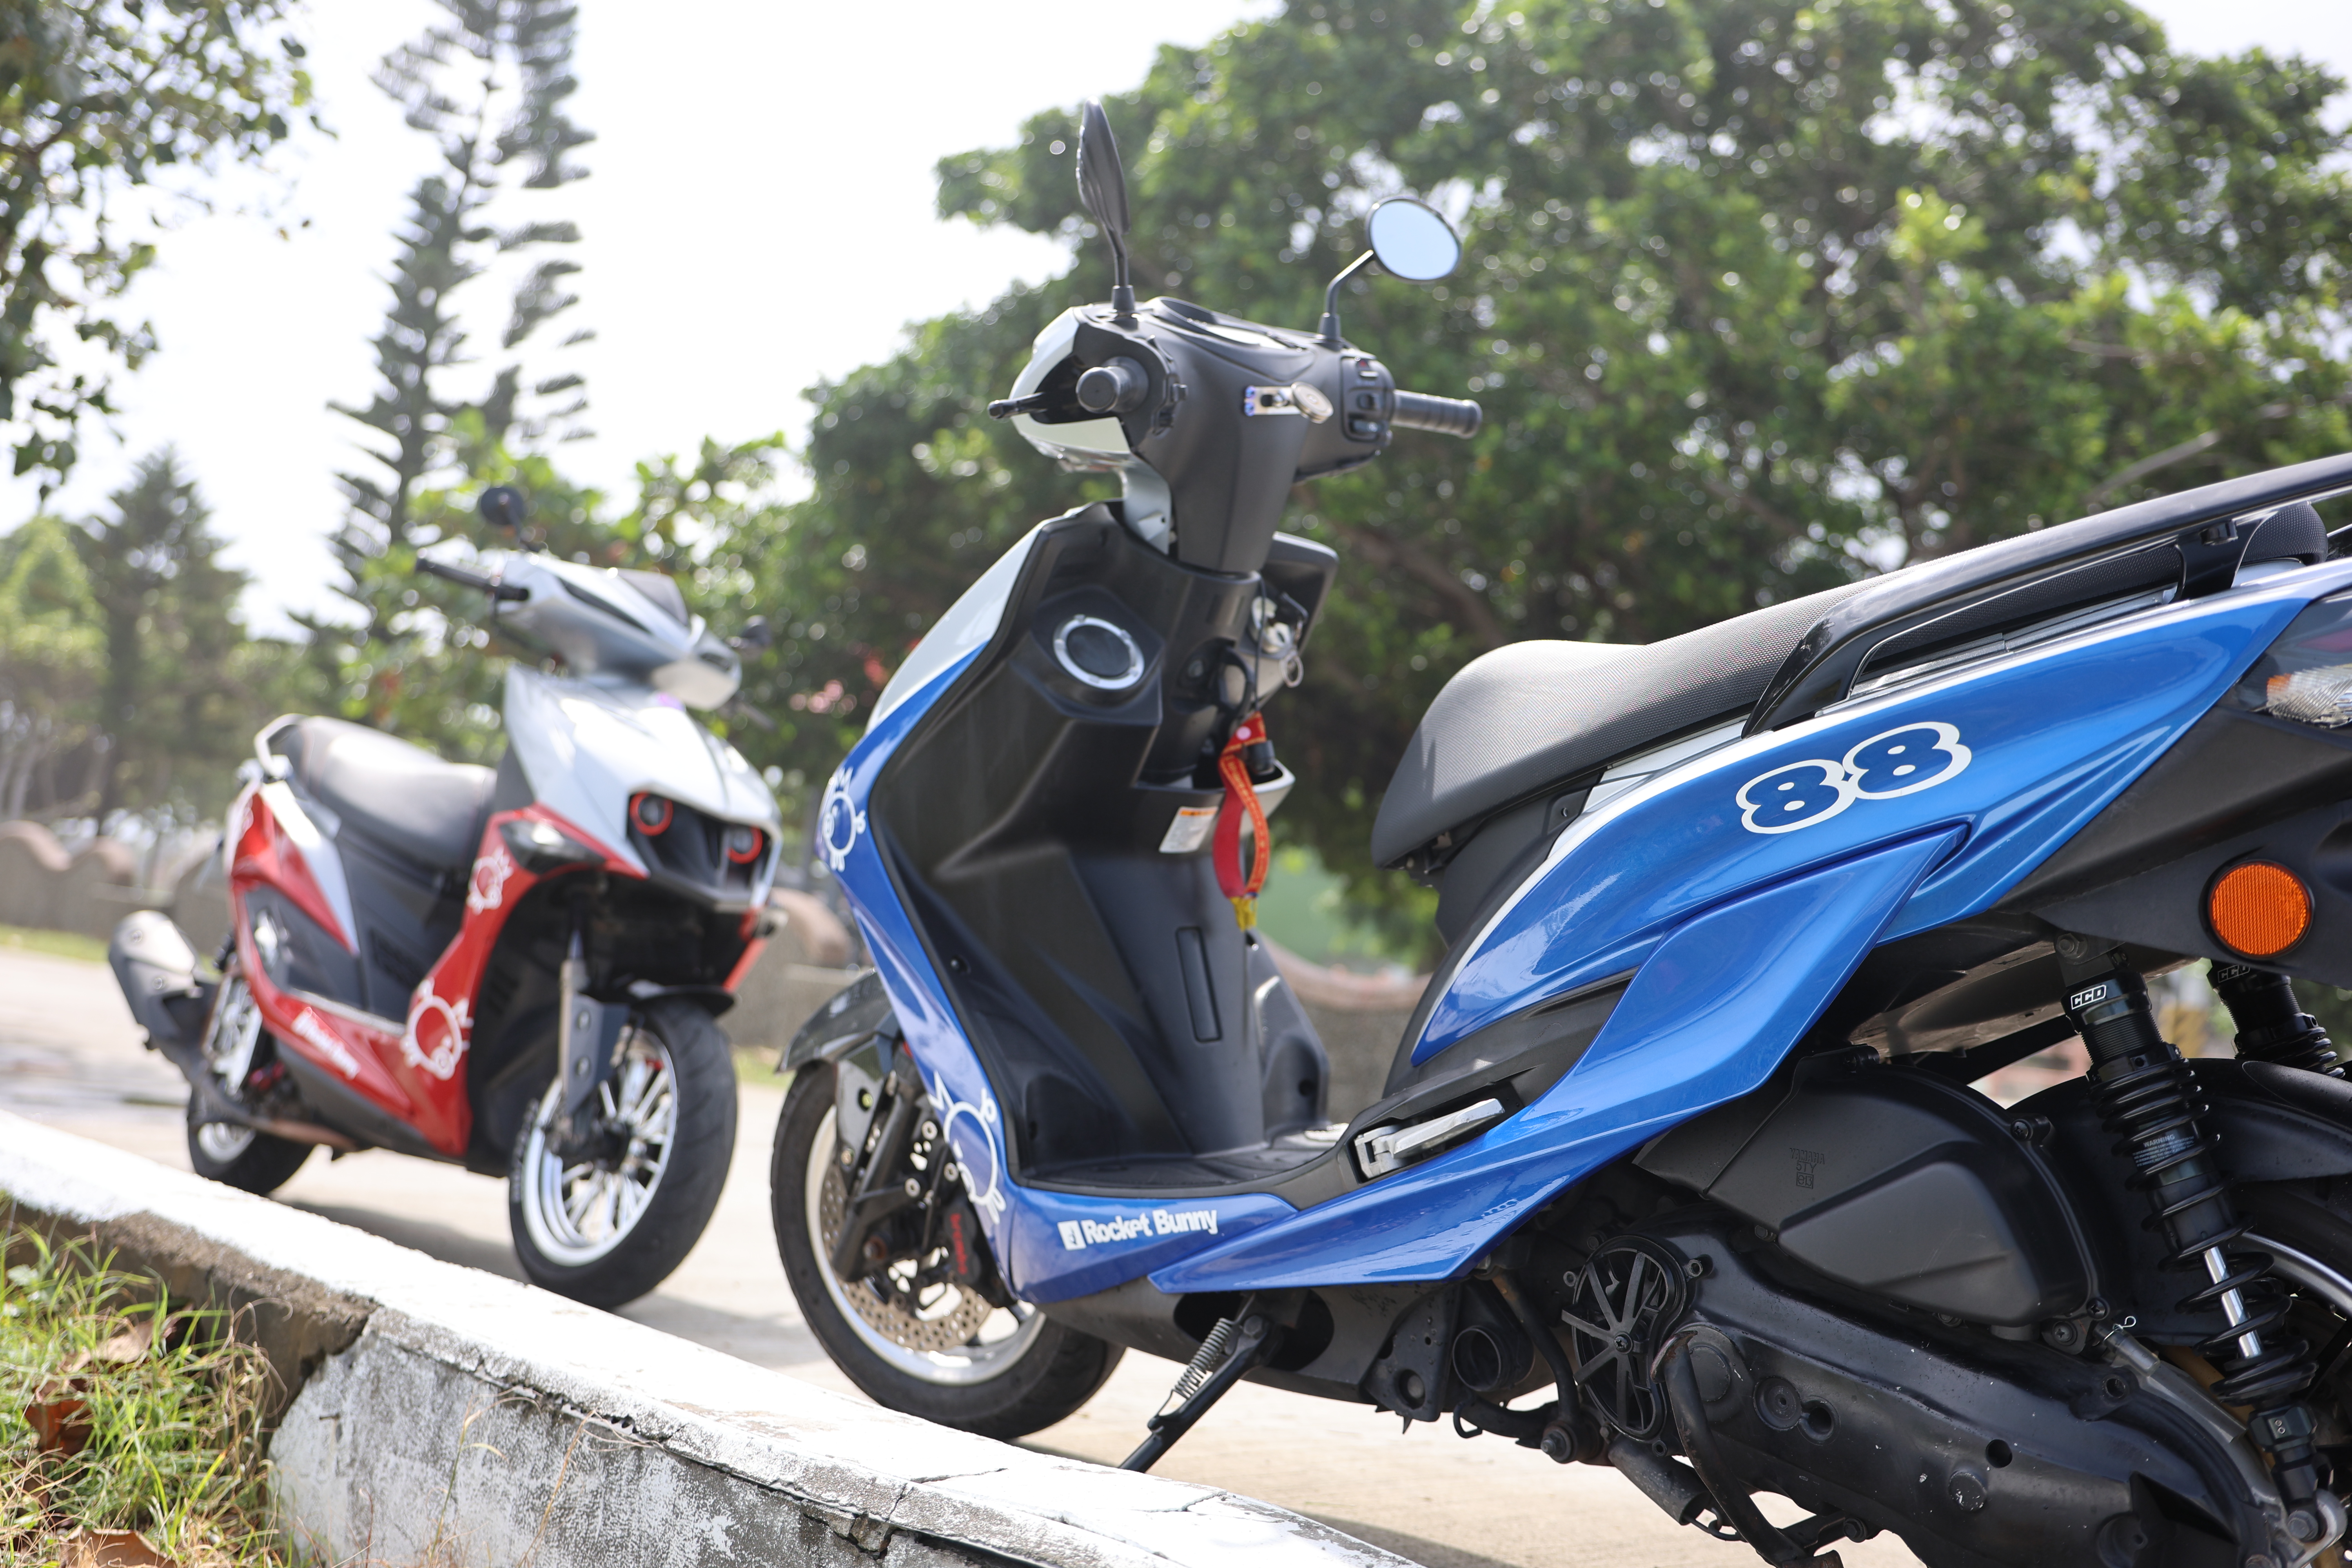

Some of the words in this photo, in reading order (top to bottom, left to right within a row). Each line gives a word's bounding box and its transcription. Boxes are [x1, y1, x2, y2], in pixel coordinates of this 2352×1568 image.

[1736, 721, 1972, 834] 88
[2071, 985, 2106, 1010] CCD
[2143, 1134, 2175, 1148] WARNING
[1789, 1147, 1825, 1165] YAMAHA
[1796, 1160, 1817, 1173] 5TY
[1798, 1174, 1813, 1187] e13
[1081, 1212, 1153, 1244] Rocket
[1152, 1209, 1218, 1235] Bunny
